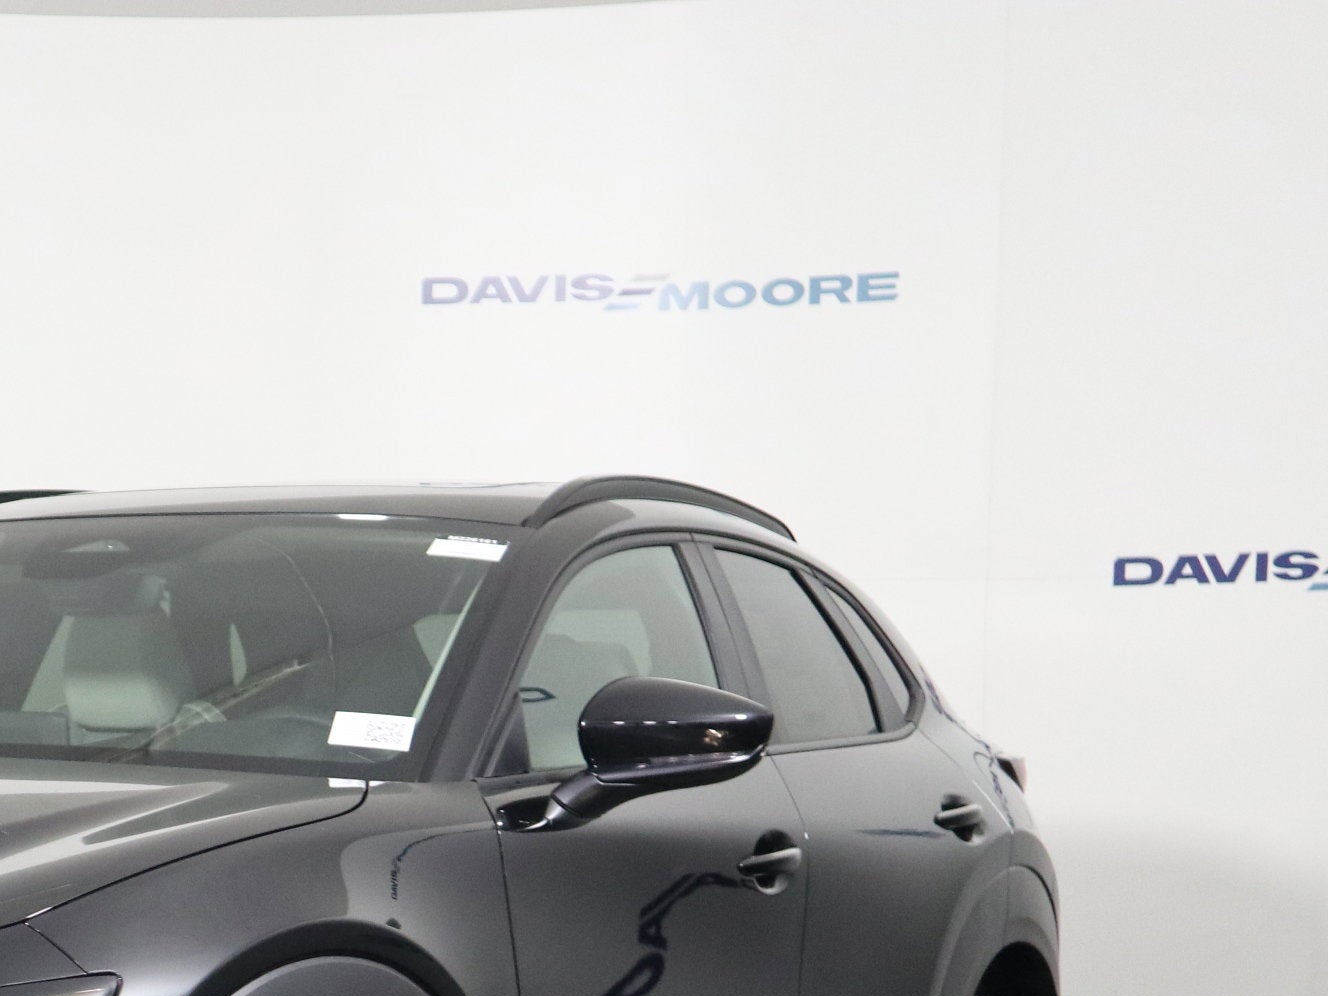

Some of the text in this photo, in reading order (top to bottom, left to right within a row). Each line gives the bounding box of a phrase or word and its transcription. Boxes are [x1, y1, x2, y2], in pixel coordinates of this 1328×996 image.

[420, 269, 902, 312] DAVIS MOORE
[1111, 549, 1321, 588] DAVIS
